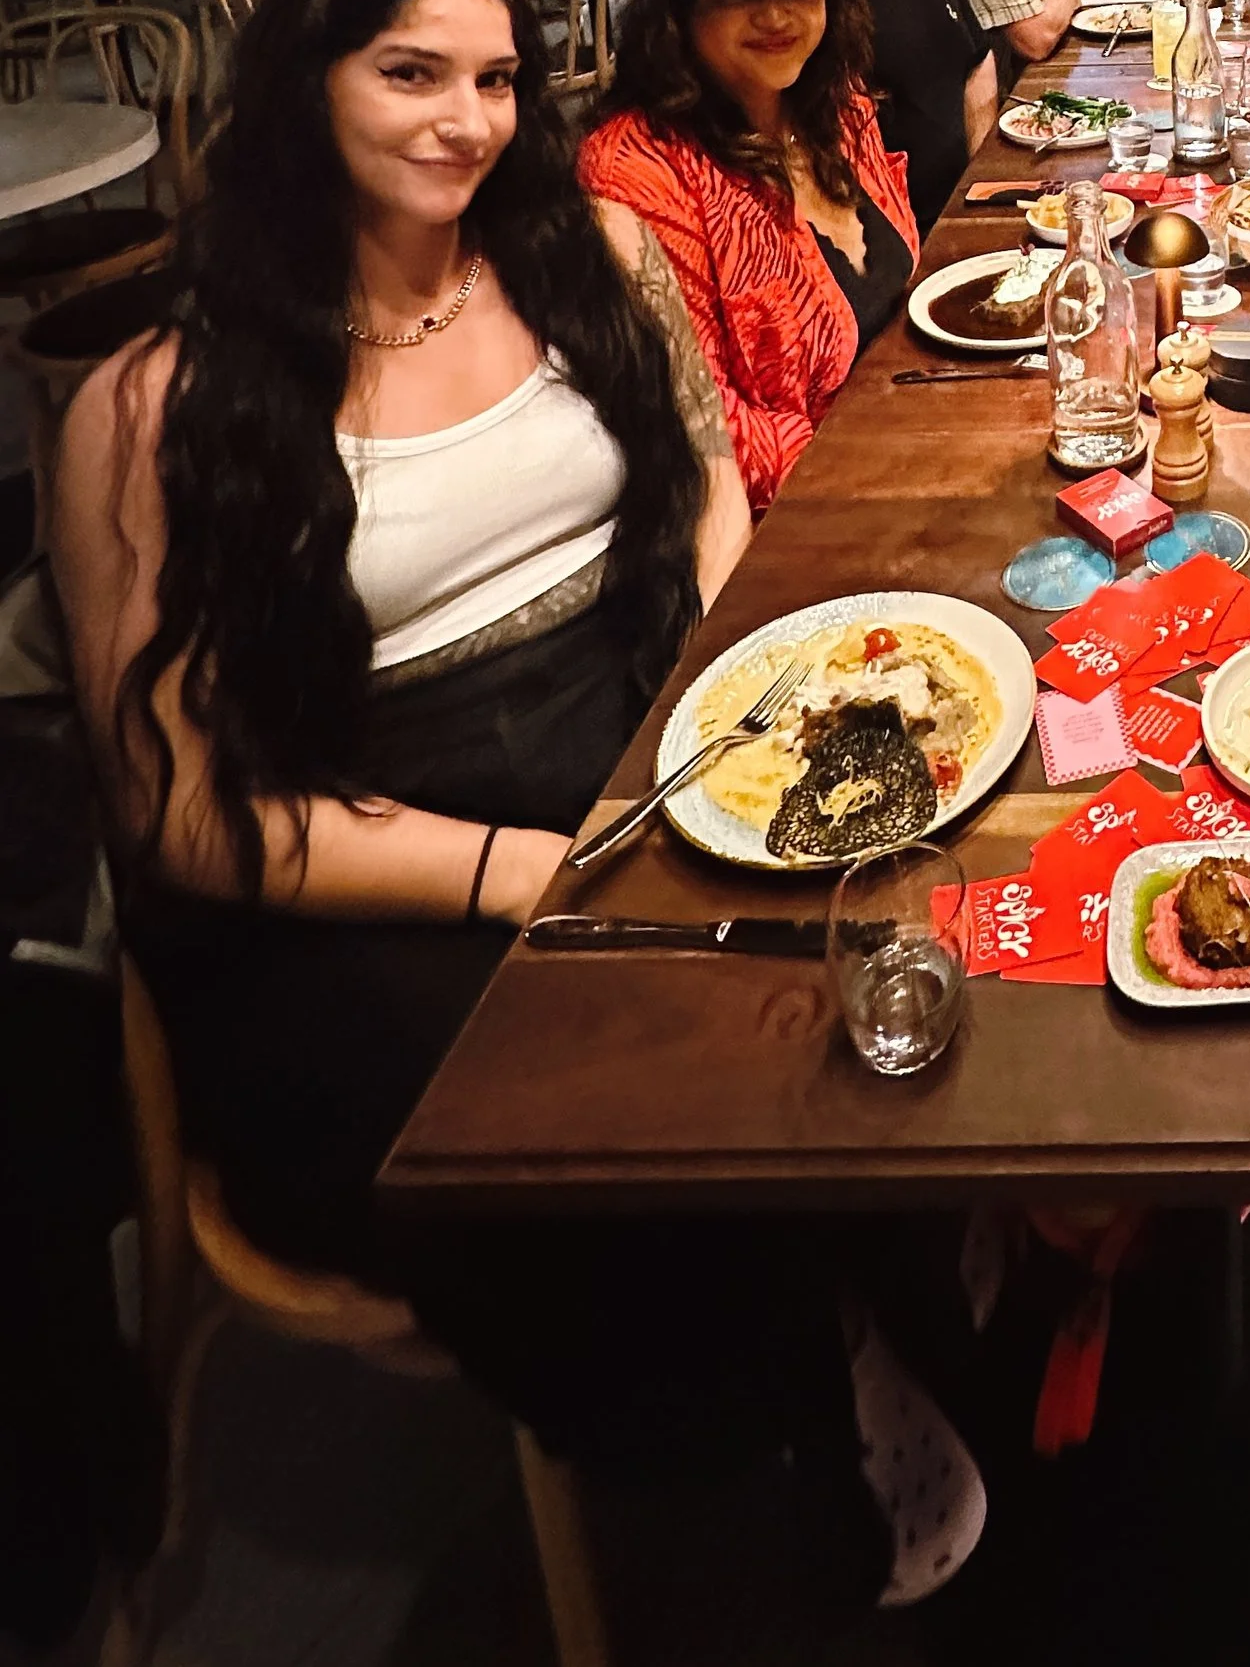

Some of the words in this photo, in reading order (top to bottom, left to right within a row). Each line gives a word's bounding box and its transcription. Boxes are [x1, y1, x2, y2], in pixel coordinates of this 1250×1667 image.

[1060, 639, 1119, 676] SPICY
[1080, 628, 1136, 661] STARTERS
[1165, 807, 1209, 841] START
[975, 887, 999, 960] STARTERS
[994, 883, 1035, 958] SPICY
